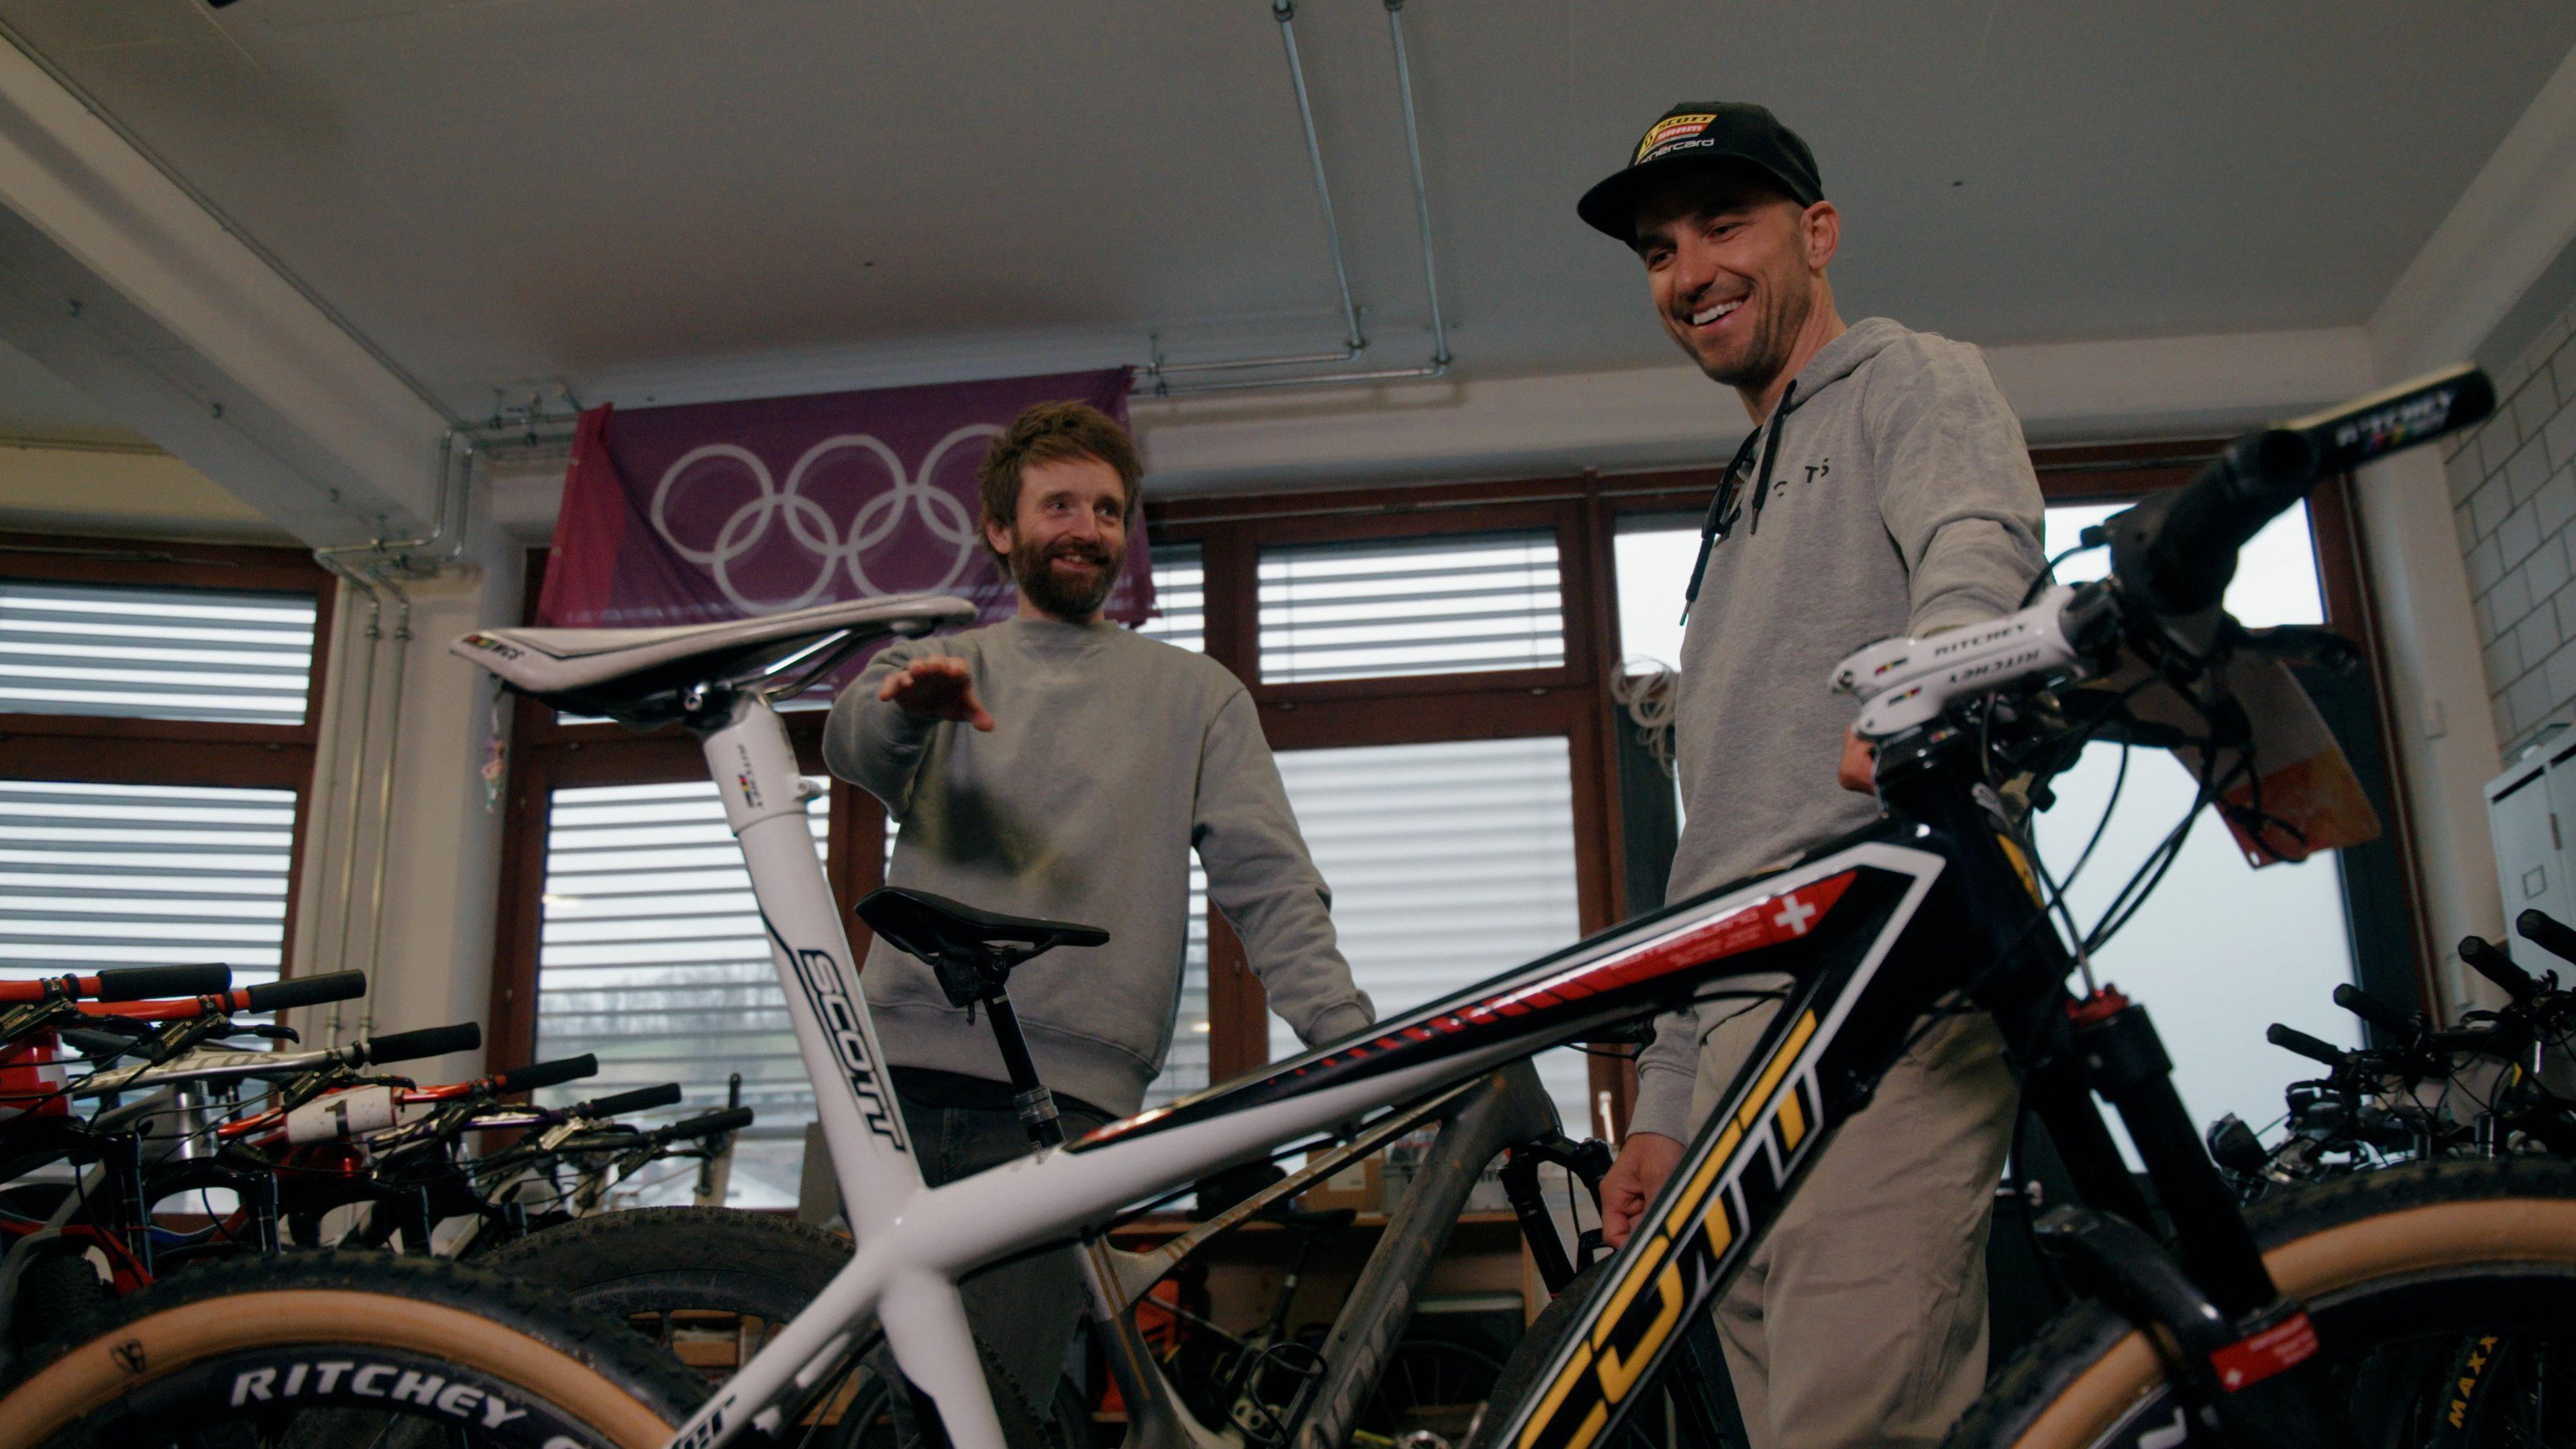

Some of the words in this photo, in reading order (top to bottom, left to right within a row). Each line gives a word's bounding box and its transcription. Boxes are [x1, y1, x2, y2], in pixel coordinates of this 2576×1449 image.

[1658, 116, 1709, 131] SCOTT
[1935, 624, 2027, 657] RITCHEY
[1948, 649, 2041, 683] RITCHEY
[738, 743, 763, 808] RITCHEY
[796, 949, 907, 1152] SCOTT
[324, 1099, 352, 1135] 1
[229, 1360, 528, 1430] RITCHEY
